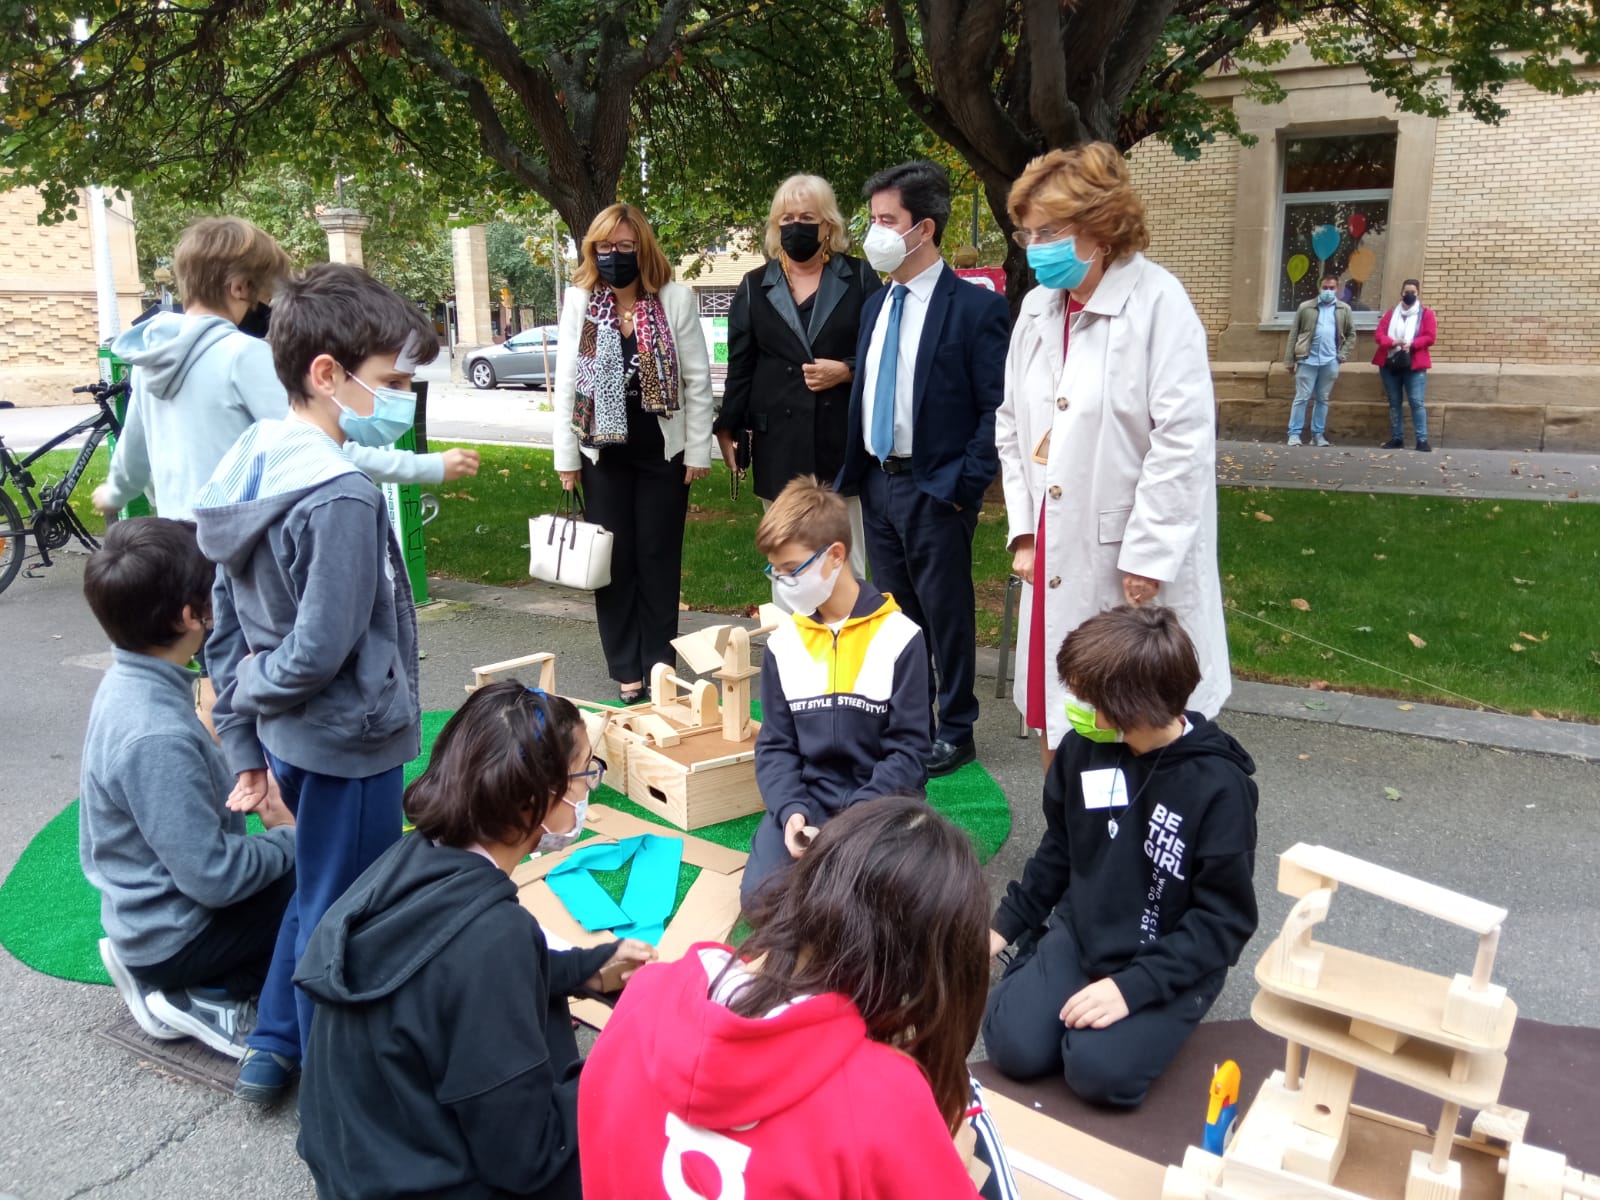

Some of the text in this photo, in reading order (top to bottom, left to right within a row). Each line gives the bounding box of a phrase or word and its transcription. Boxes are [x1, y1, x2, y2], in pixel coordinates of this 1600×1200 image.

[808, 698, 832, 710] STYLE
[837, 696, 866, 709] STREET
[1151, 803, 1183, 833] BE
[1148, 821, 1186, 860] THE
[1143, 839, 1185, 881] GIRL
[1152, 866, 1160, 881] TO
[1147, 886, 1155, 901] GO
[1155, 878, 1166, 900] WHO
[1140, 908, 1151, 931] FOR
